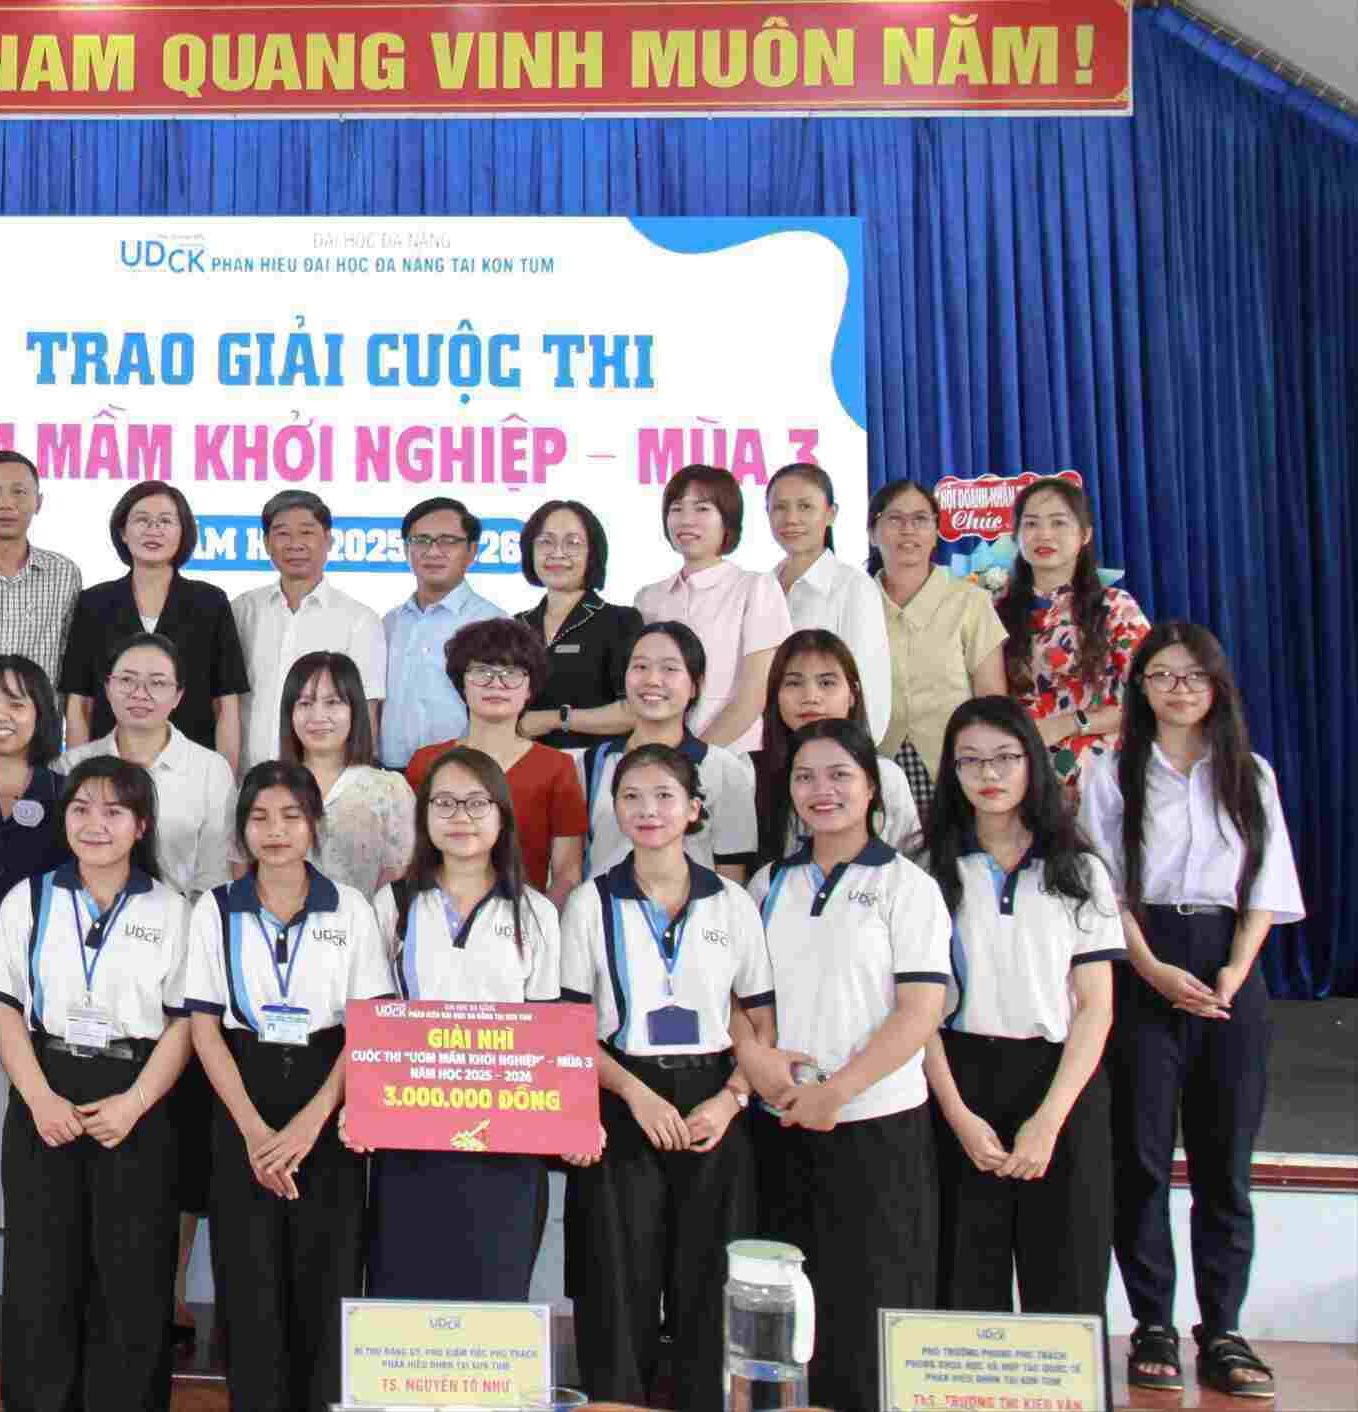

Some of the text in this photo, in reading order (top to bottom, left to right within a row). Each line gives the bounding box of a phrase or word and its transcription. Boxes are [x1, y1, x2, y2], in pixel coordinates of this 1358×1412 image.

[161, 32, 406, 98] QUANG
[430, 30, 603, 90] VINH
[631, 16, 854, 88] MUÔN
[119, 239, 206, 274] UDCK
[481, 256, 514, 273] KON
[520, 256, 555, 273] TUM
[26, 314, 654, 405] TRAO GIẢI CUỘC THI
[37, 403, 172, 480] MẦM
[194, 408, 333, 483] KHỞI
[354, 412, 567, 492] NGHIỆP
[638, 416, 769, 485] MÙA
[427, 1023, 515, 1050] GIẢI NHÌ
[464, 1069, 493, 1081] 2025
[384, 1083, 562, 1112] 3.000.000 ĐỒNG
